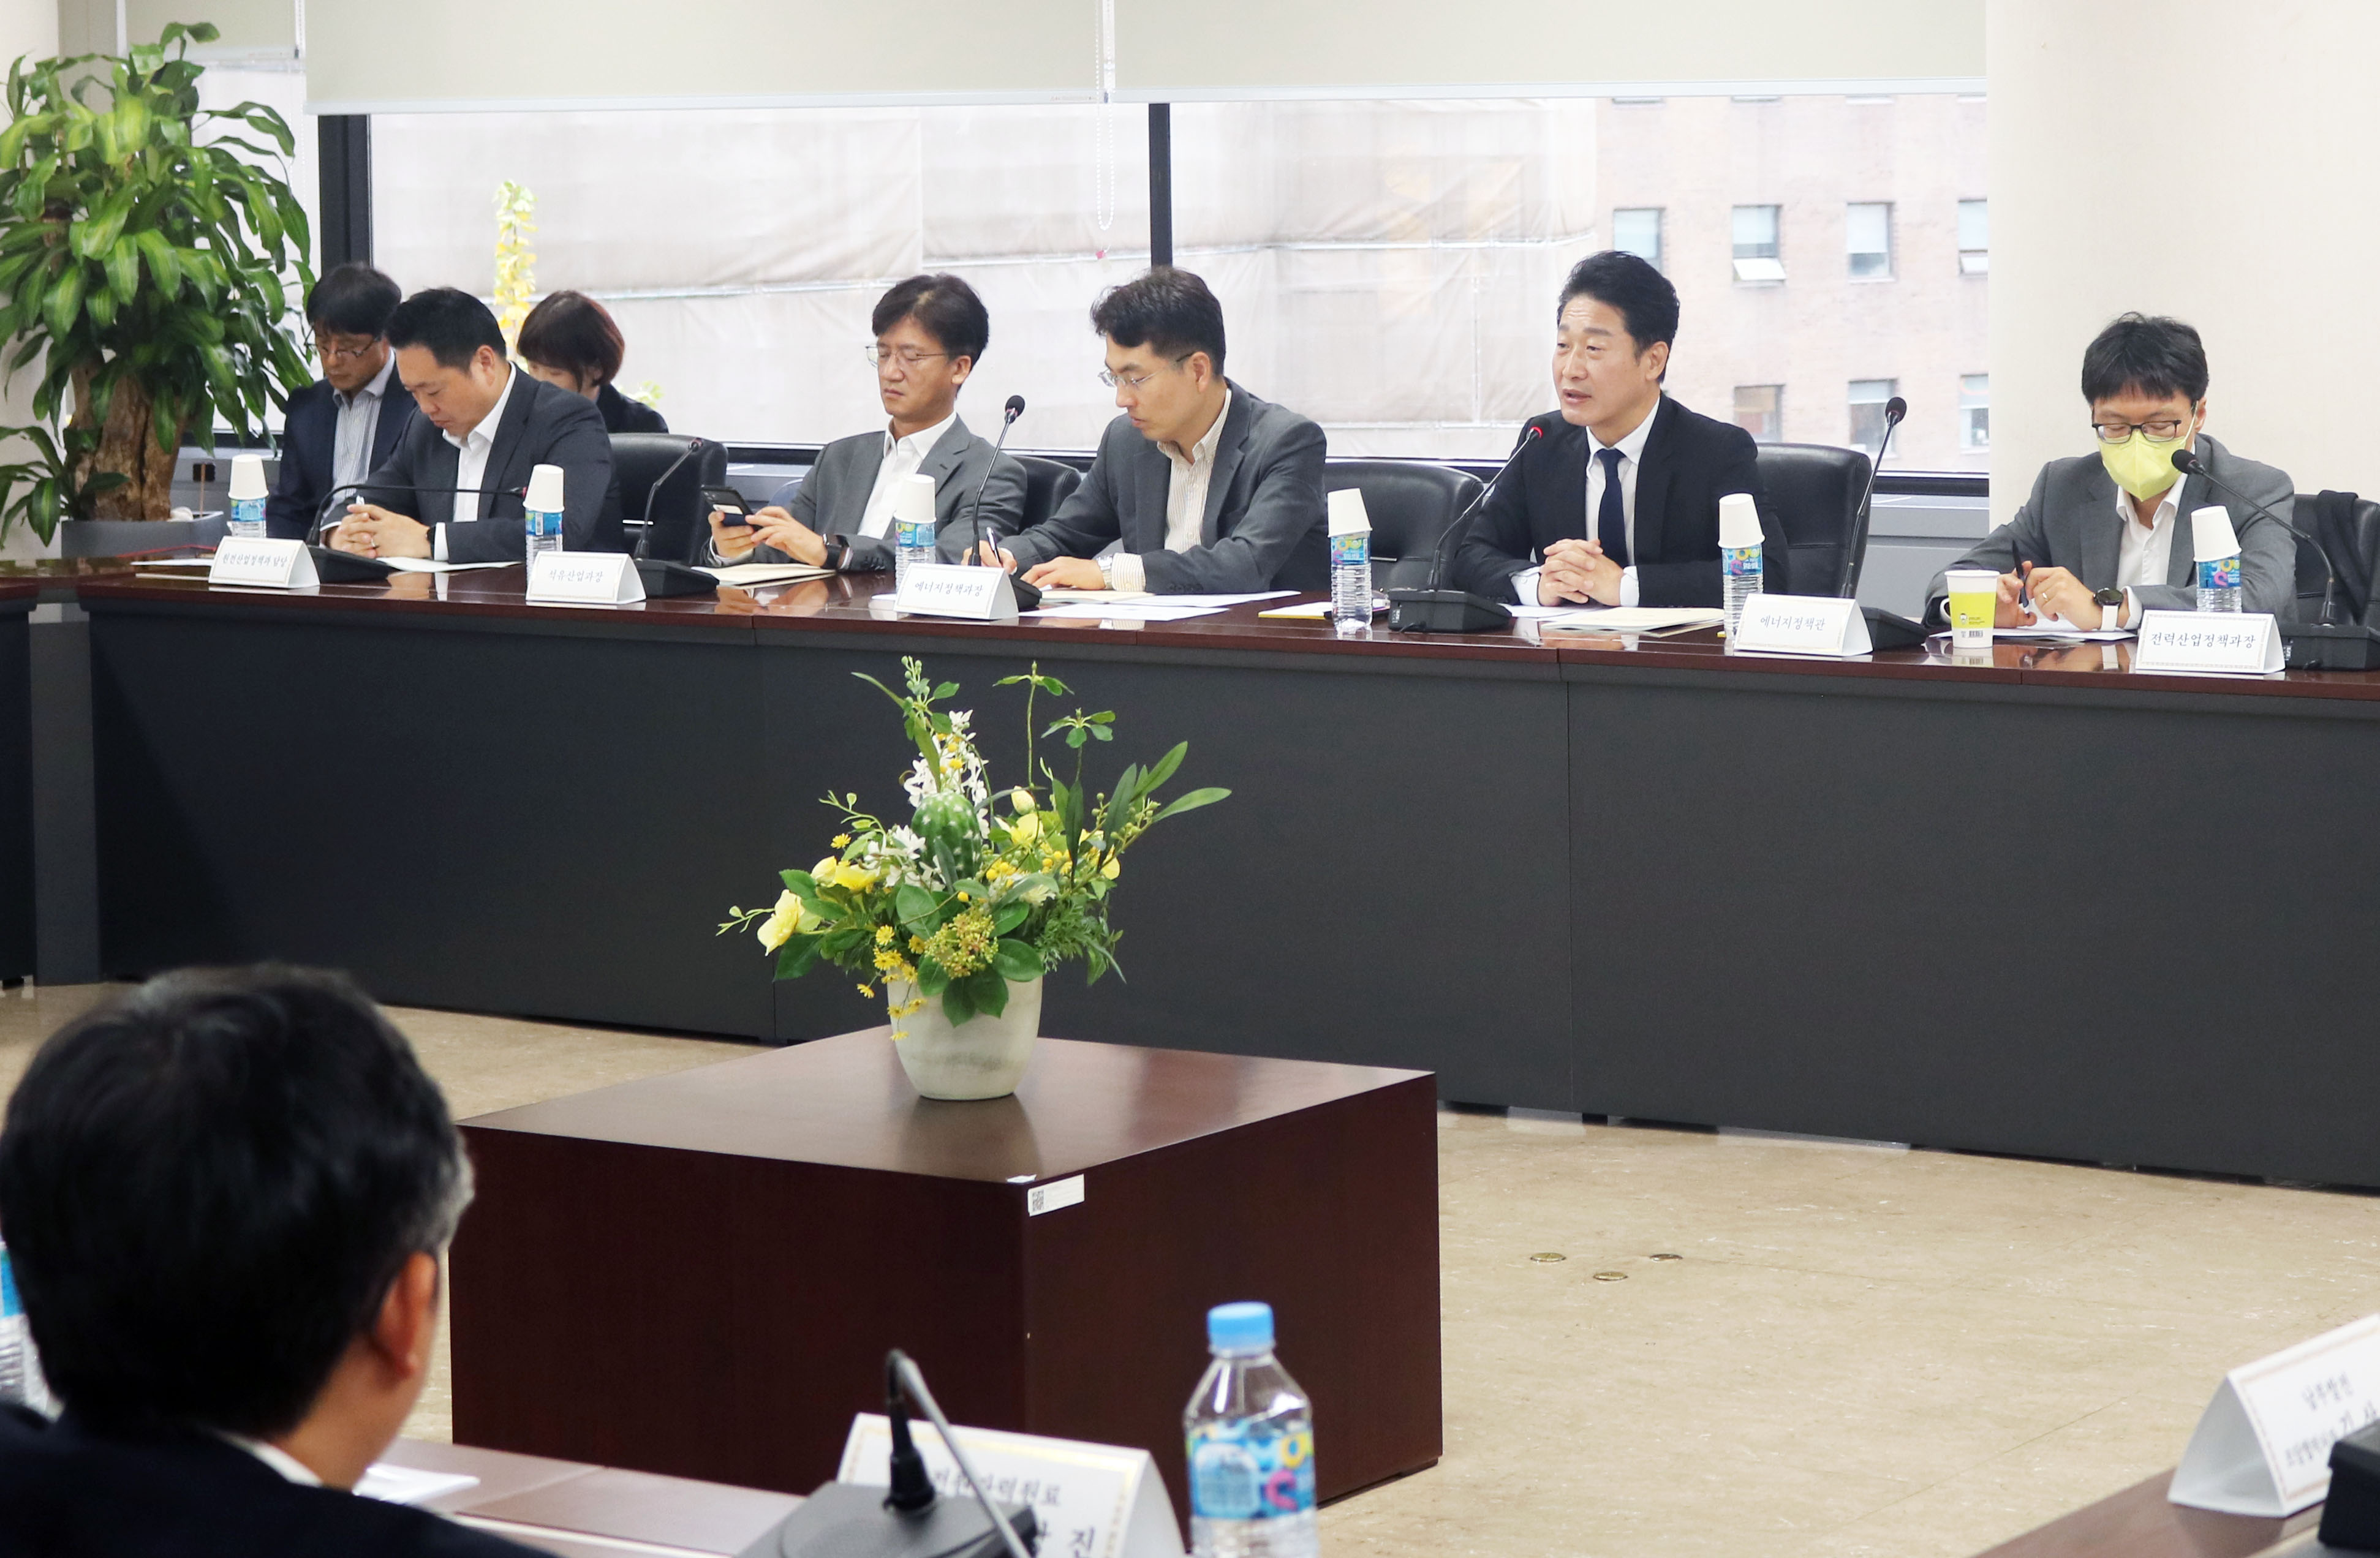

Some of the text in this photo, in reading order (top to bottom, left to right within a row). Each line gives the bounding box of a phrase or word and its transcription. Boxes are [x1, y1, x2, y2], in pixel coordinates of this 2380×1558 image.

[550, 569, 603, 583] 석유산업과장
[915, 581, 984, 597] 에너지정책과장
[1760, 615, 1826, 631] 에너지정책관
[2151, 632, 2256, 649] 전력산업정책과장
